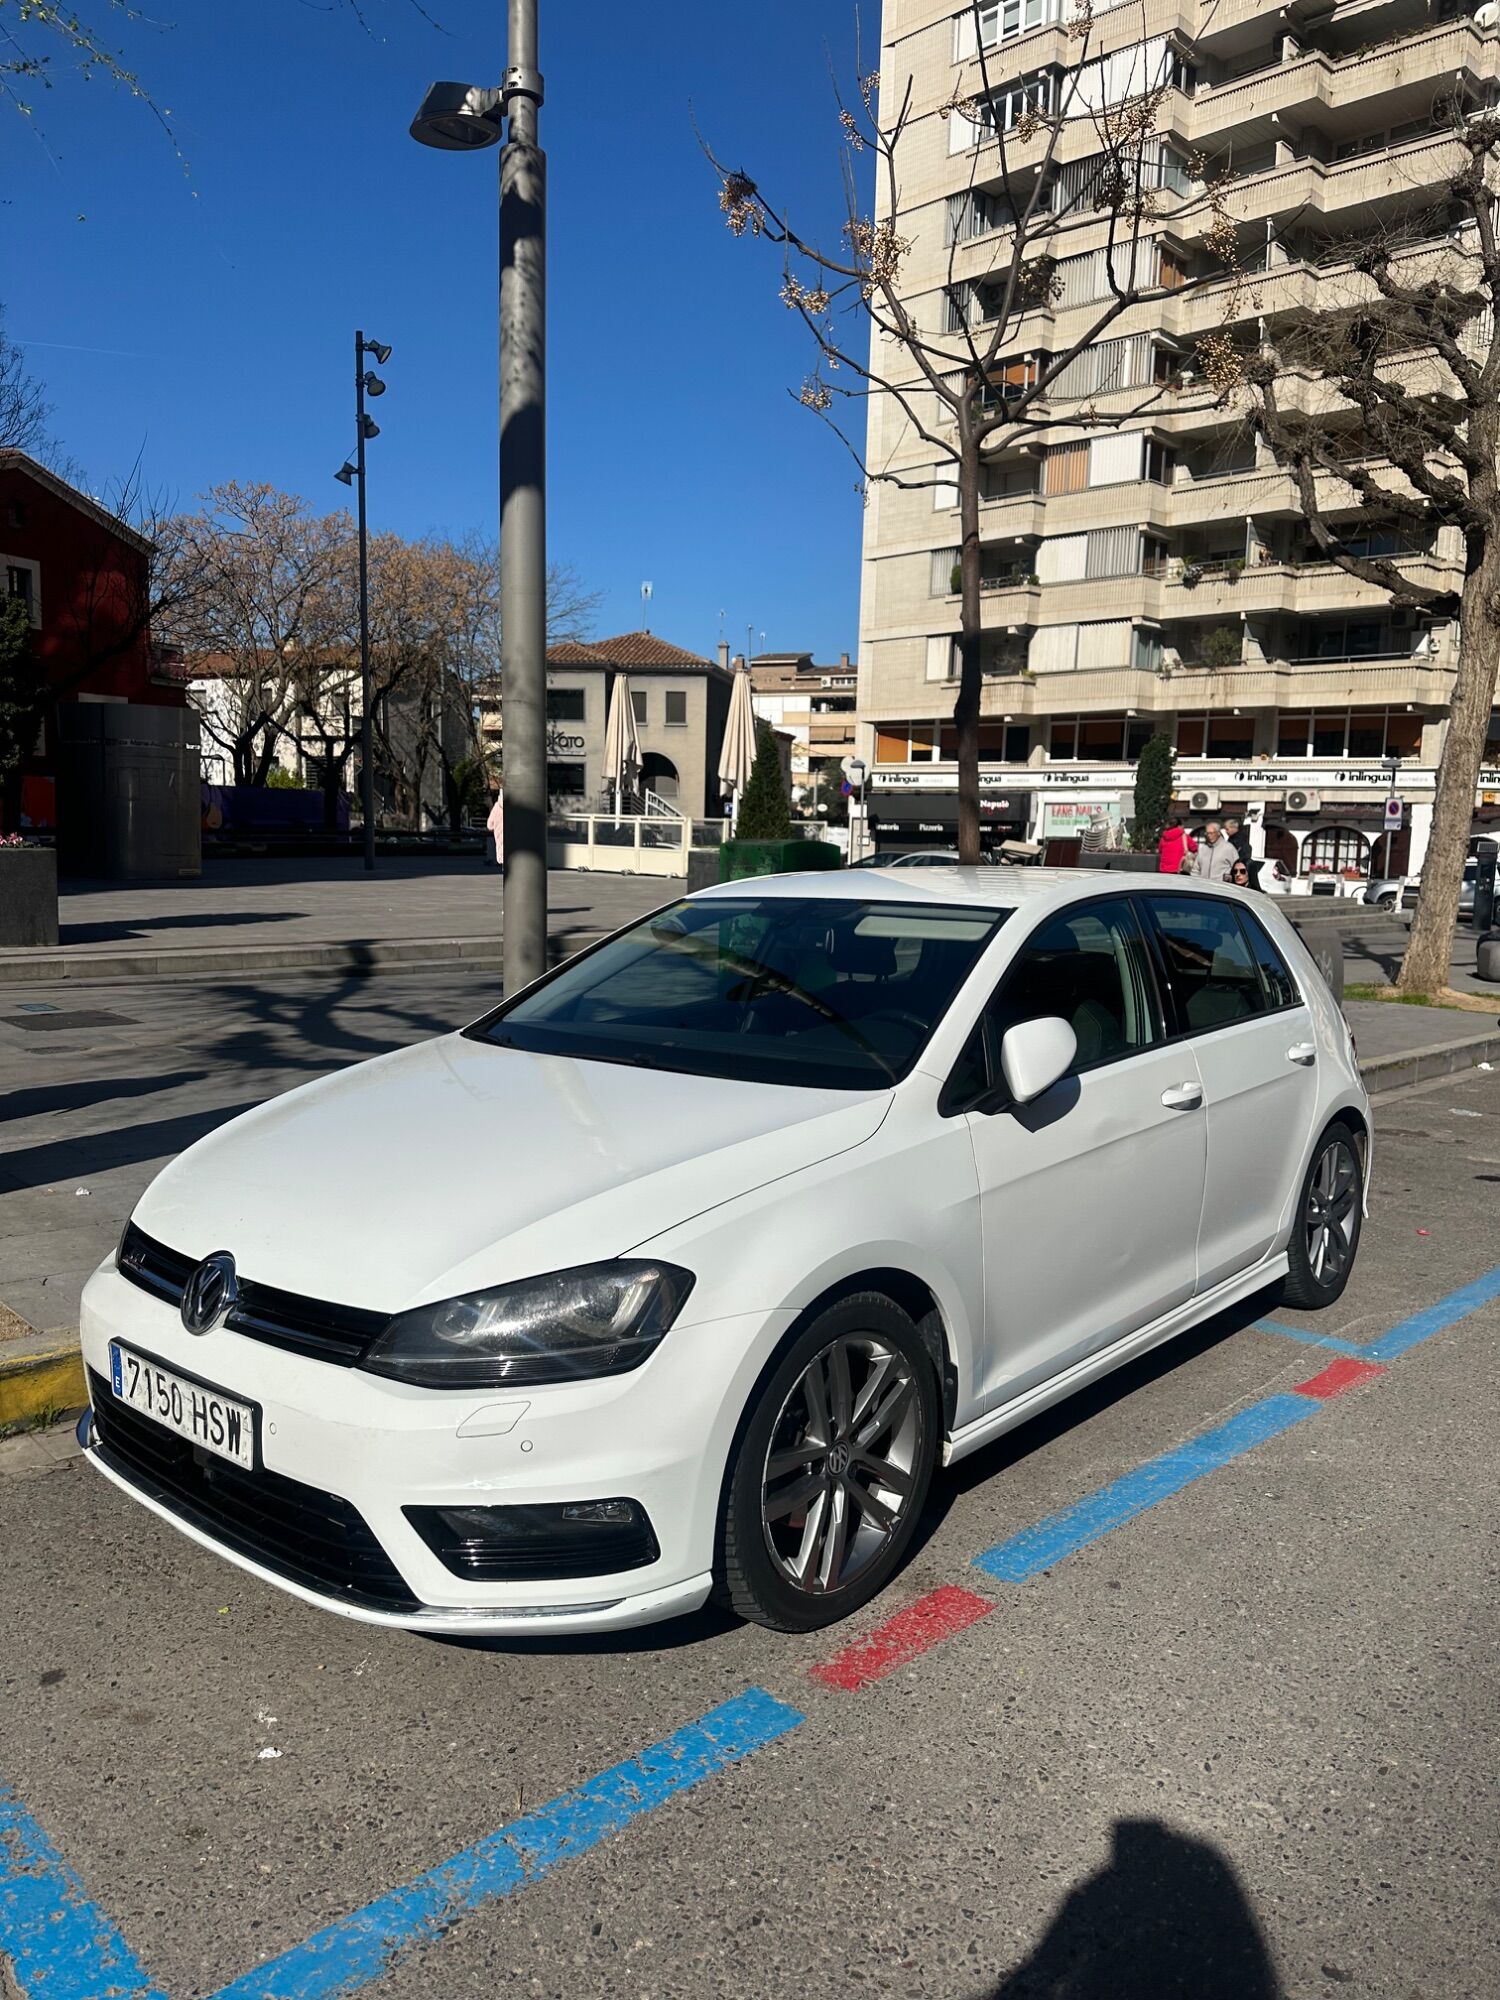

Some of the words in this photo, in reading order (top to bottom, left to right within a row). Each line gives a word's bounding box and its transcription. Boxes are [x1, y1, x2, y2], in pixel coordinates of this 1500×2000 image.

[888, 774, 920, 785] inlingua
[980, 776, 1002, 785] ngua
[1054, 772, 1090, 784] inlingua
[1247, 771, 1288, 784] inlingua
[1348, 771, 1392, 784] inlingua
[1480, 772, 1500, 784] inlin
[127, 1356, 183, 1425] 7150
[192, 1391, 242, 1455] HSW
